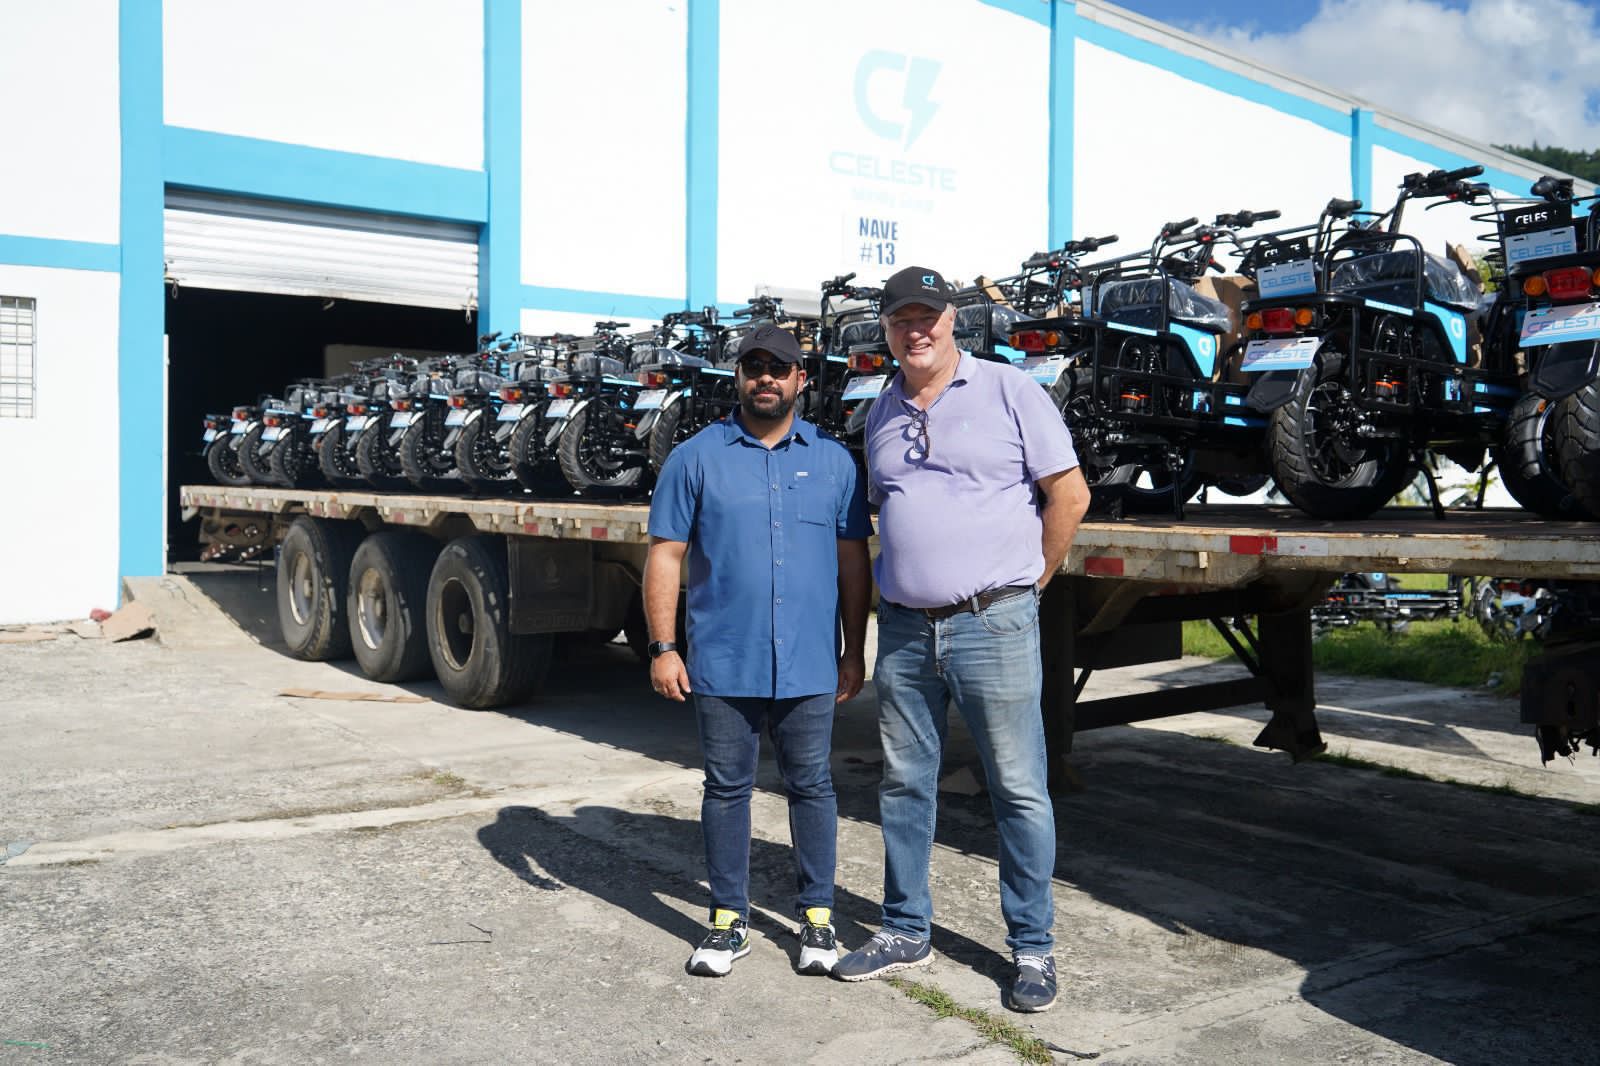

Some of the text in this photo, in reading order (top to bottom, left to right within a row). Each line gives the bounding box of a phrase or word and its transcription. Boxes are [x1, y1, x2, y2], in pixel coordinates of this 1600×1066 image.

[829, 151, 958, 192] CELESTE
[859, 216, 898, 241] NAVE
[859, 242, 896, 266] #13
[1509, 240, 1572, 260] CELESTE
[1262, 271, 1311, 289] CELESTE
